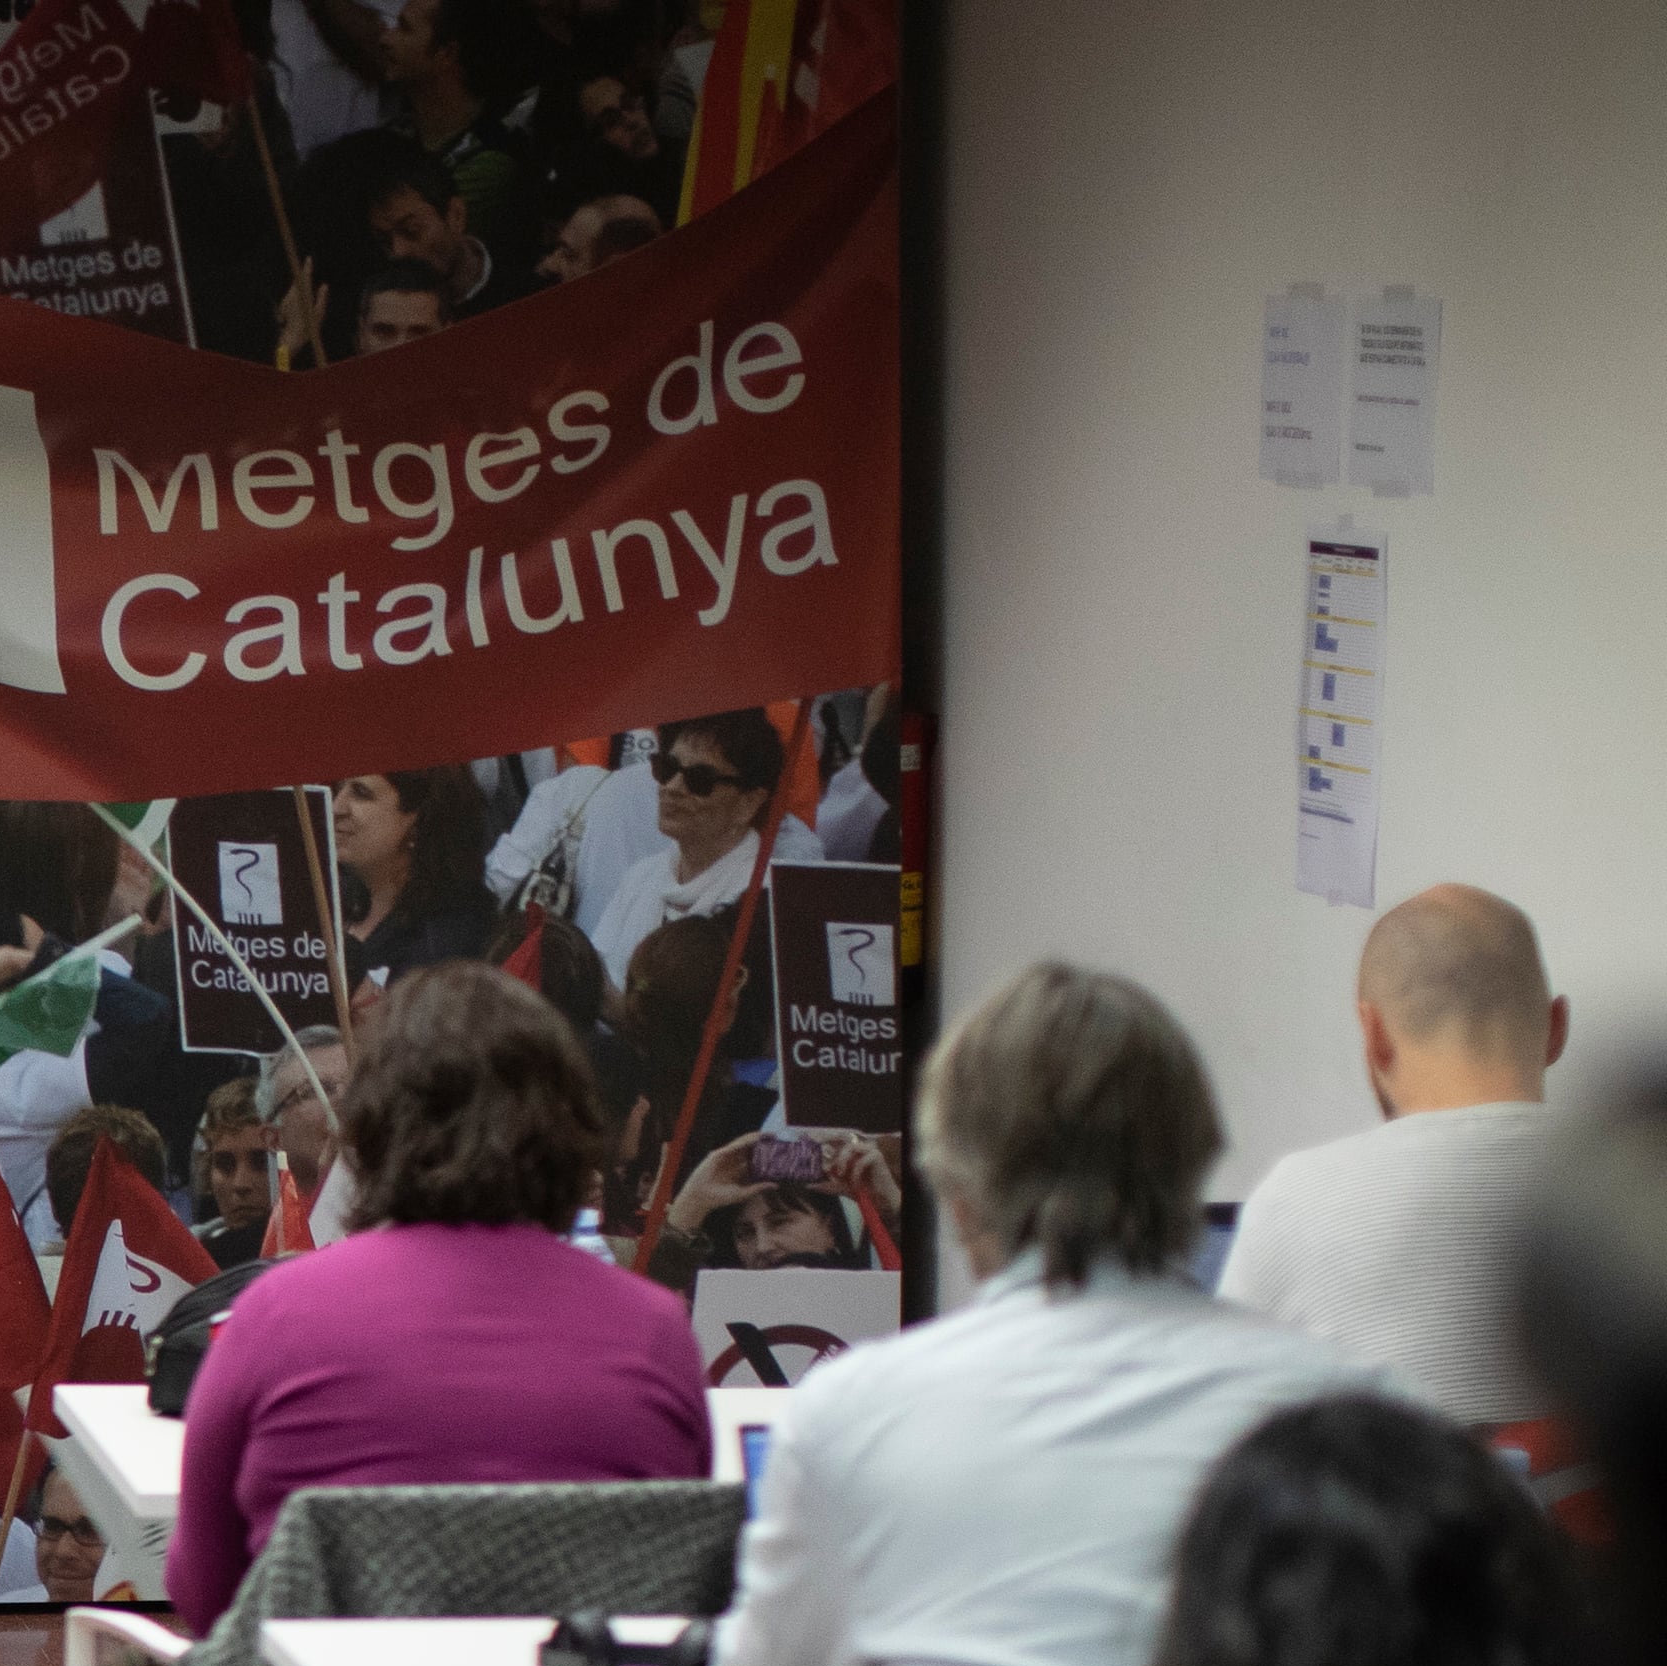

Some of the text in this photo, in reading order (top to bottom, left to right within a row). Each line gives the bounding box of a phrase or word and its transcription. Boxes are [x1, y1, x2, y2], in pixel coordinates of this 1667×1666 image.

[0, 240, 163, 287] Metges de
[92, 319, 806, 552] Metges de
[100, 478, 839, 692] Catalunya
[294, 931, 327, 960] de
[191, 960, 330, 1000] Cataunya
[790, 1004, 897, 1042] Metges
